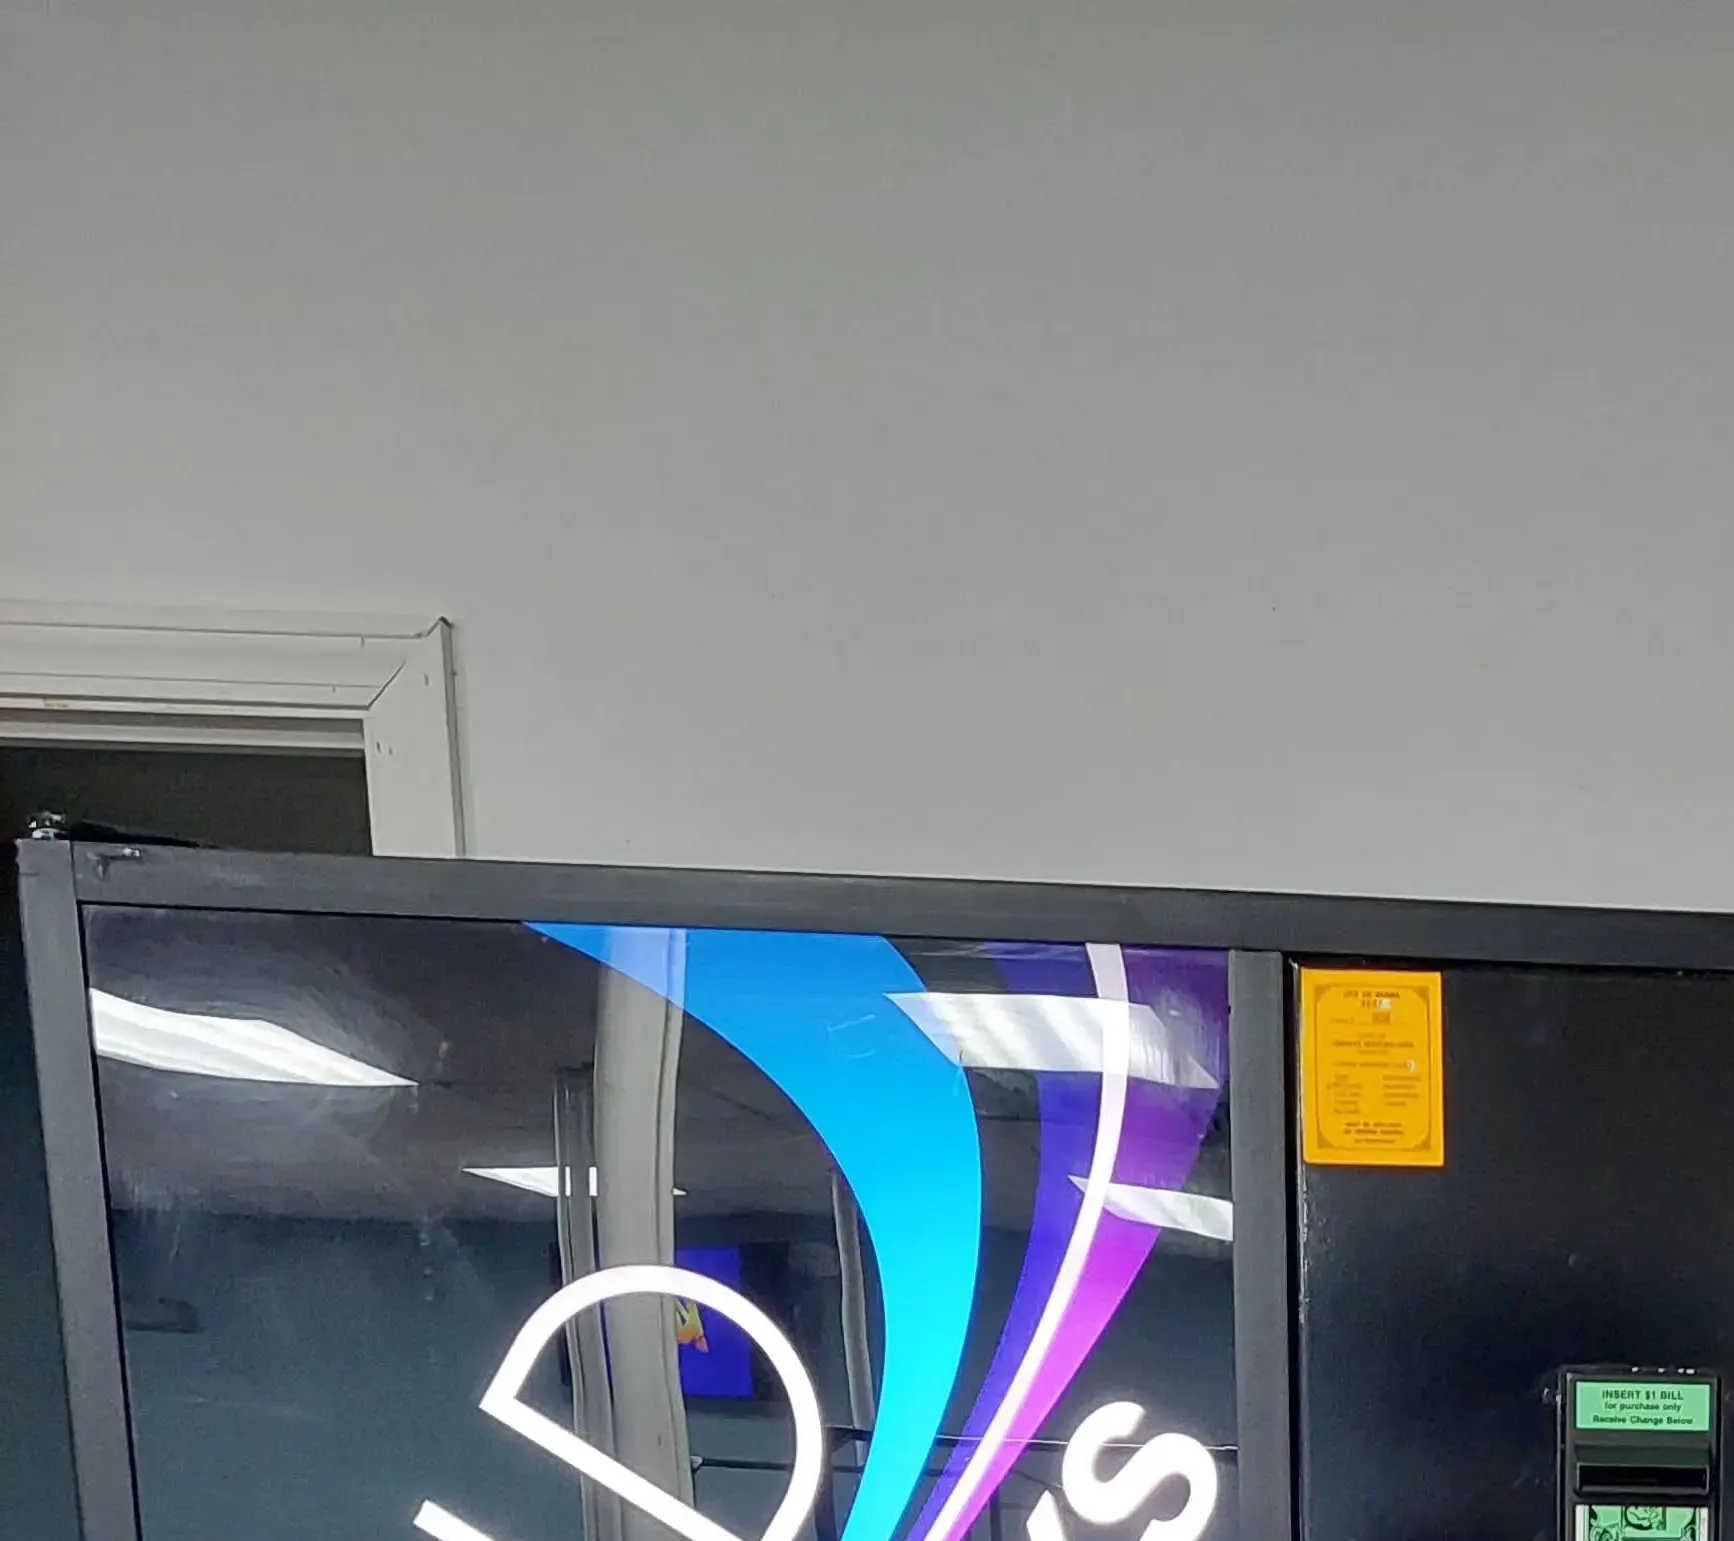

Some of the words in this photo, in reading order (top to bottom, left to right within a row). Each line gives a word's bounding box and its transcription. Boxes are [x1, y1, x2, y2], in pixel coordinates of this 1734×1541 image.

[1602, 1390, 1640, 1399] INSERT
[1645, 1390, 1656, 1399] $1
[1660, 1390, 1684, 1399] BILL
[1605, 1402, 1617, 1410] for
[1620, 1403, 1659, 1411] purchase
[1662, 1404, 1681, 1412] only
[1593, 1415, 1626, 1424] Receive
[1630, 1416, 1663, 1425] Change
